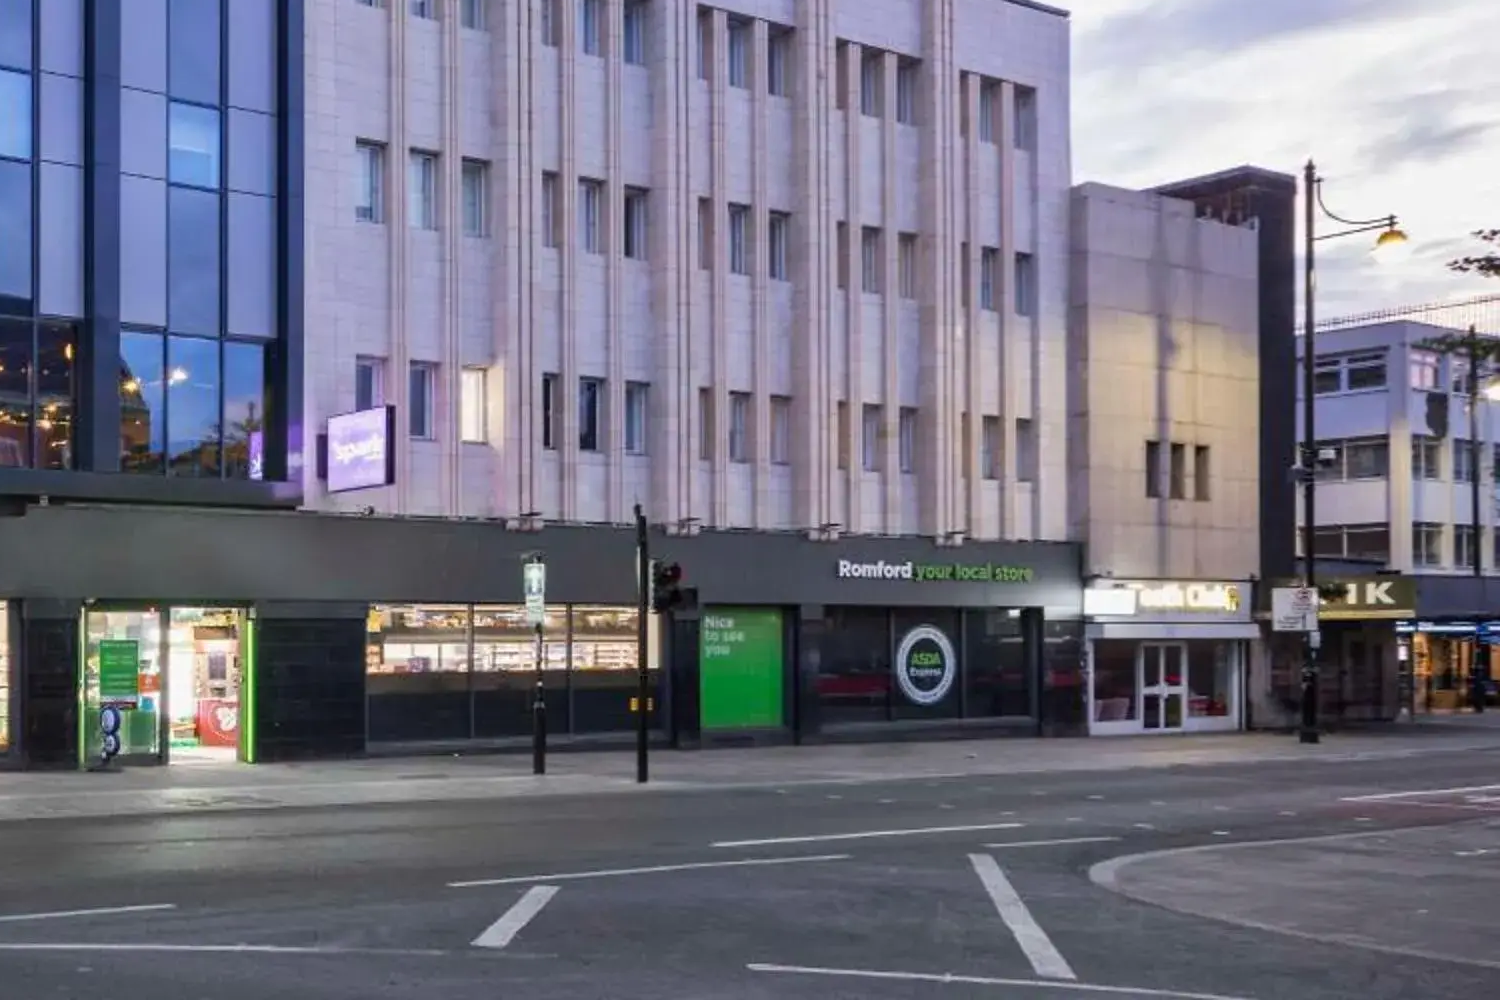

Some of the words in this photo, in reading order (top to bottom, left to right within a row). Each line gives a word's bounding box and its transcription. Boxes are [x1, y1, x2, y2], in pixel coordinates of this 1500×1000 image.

[838, 559, 913, 579] Romford
[915, 564, 952, 582] your
[955, 561, 991, 580] local
[995, 564, 1034, 582] store
[704, 615, 735, 629] Nice
[911, 652, 941, 666] ASDA
